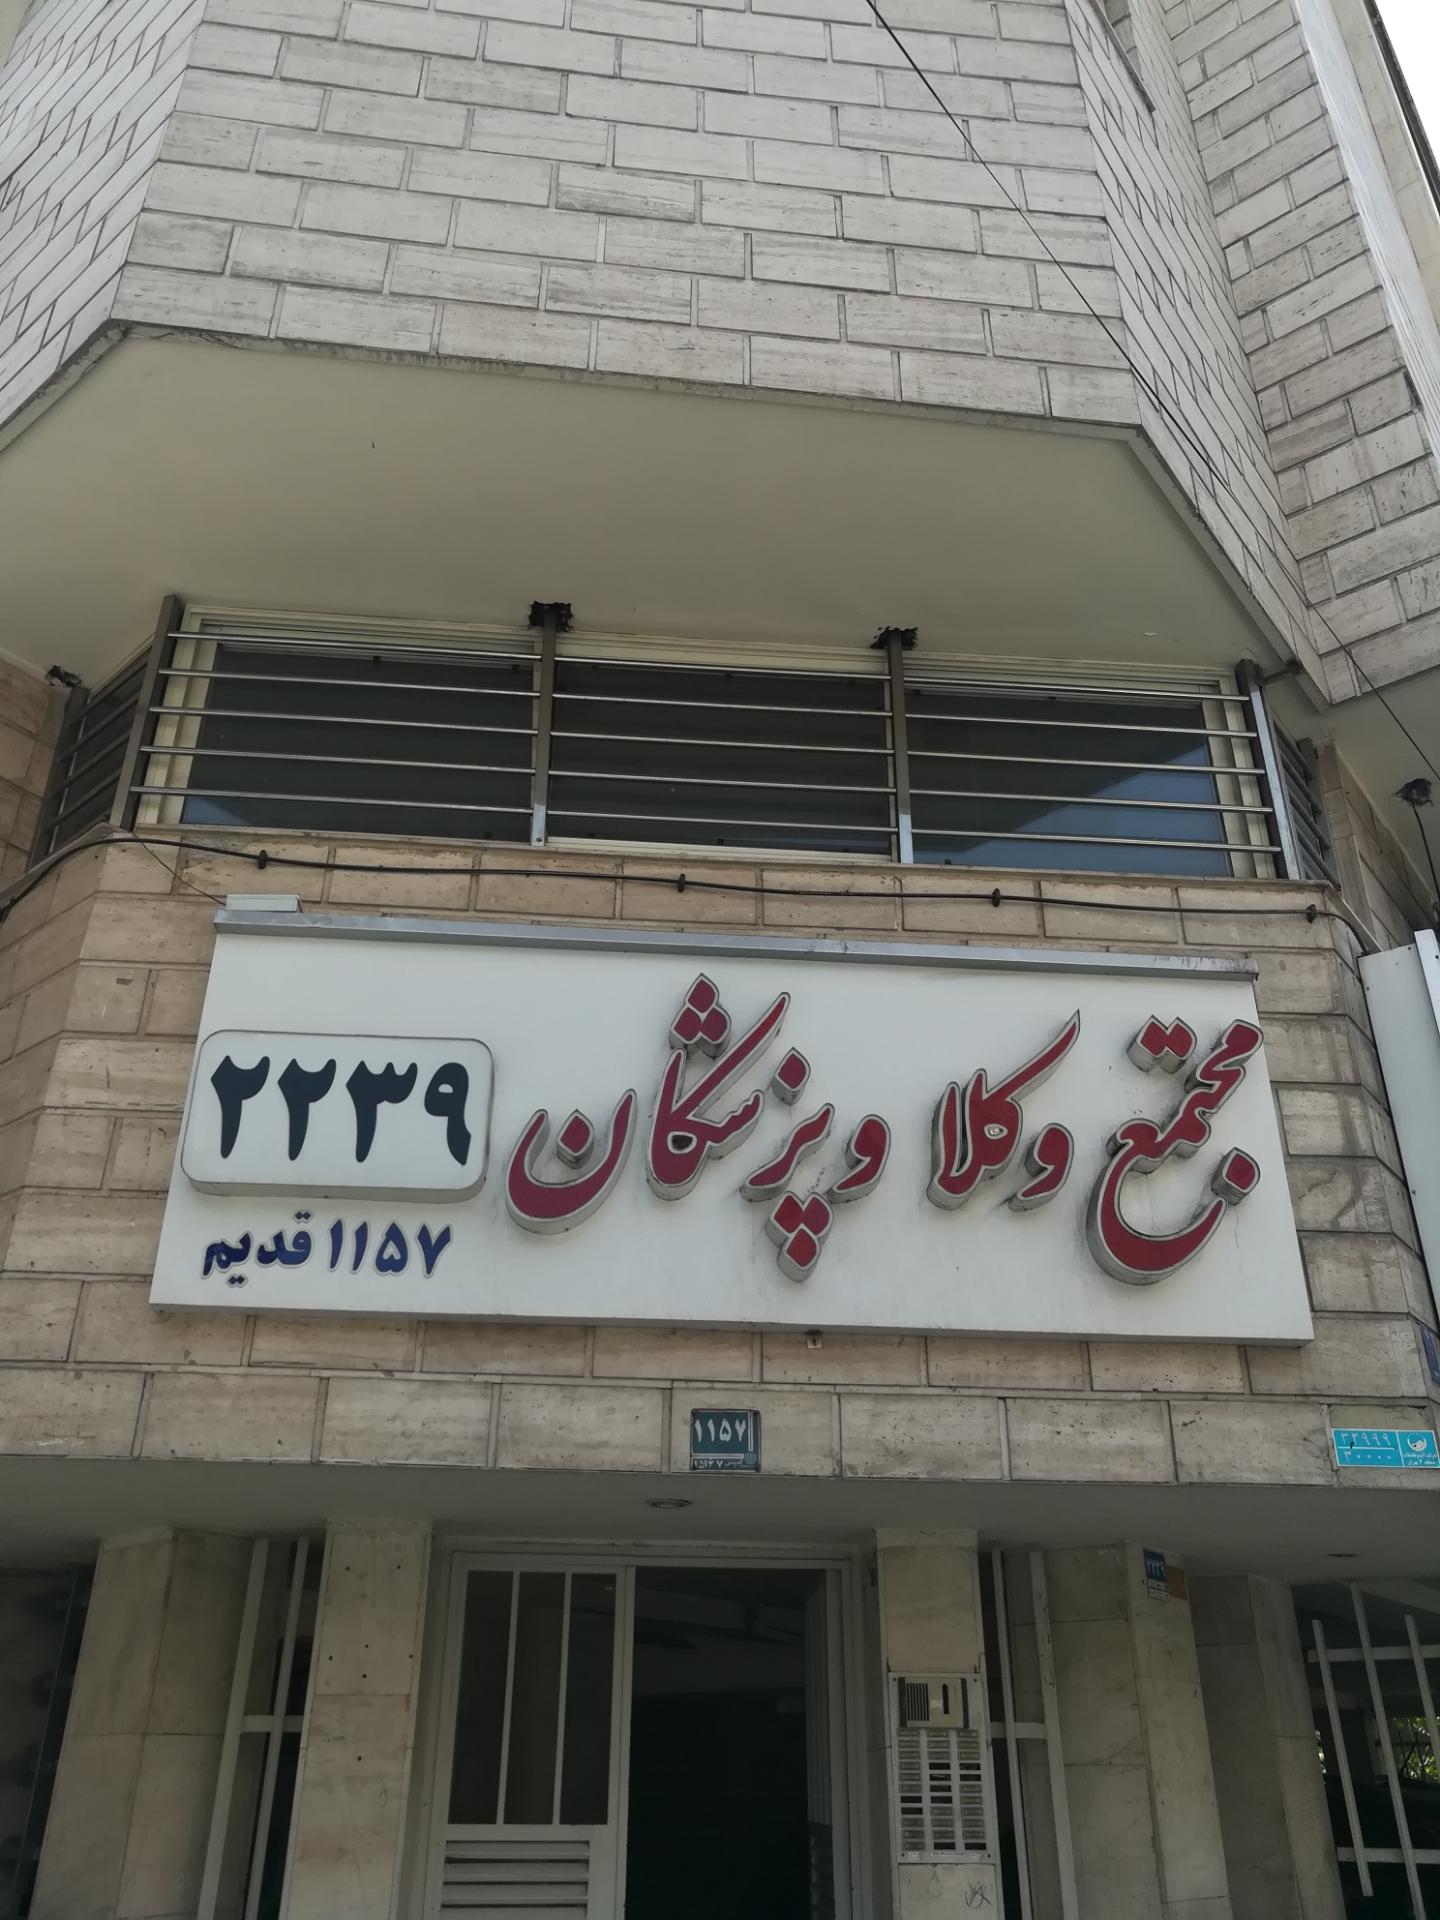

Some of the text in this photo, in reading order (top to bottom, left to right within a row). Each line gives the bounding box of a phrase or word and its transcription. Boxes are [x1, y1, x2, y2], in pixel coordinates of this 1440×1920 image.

[210, 1054, 473, 1167] ۲۲۳۹
[506, 973, 835, 1282] پزشکان
[1088, 1015, 1264, 1285] مجتمع
[199, 1209, 453, 1288] ۱۱۵۷ قدیم
[694, 1418, 747, 1443] ۱۱۵۷
